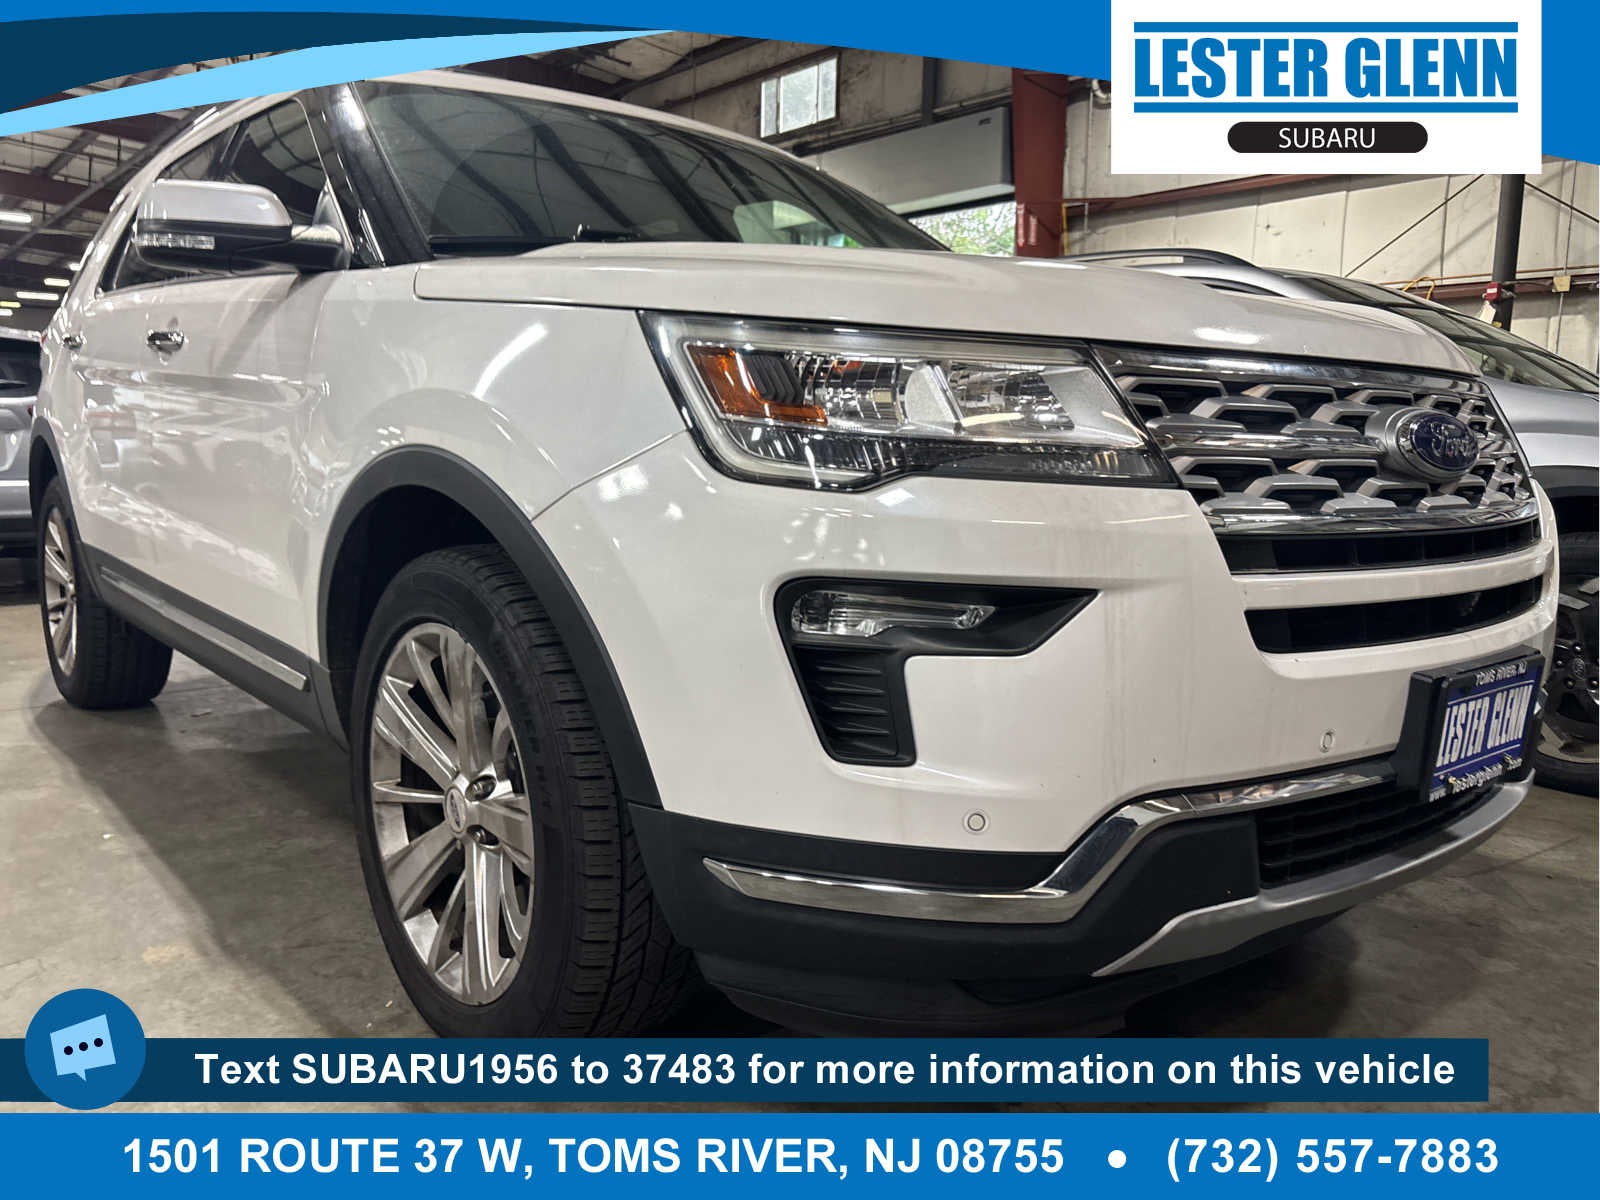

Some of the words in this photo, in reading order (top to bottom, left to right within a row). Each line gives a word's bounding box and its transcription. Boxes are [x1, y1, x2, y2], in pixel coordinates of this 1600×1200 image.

[1476, 669, 1496, 686] TOMS
[1518, 660, 1528, 675] NJ
[1435, 696, 1490, 767] LESTER
[1487, 684, 1533, 749] GLENN
